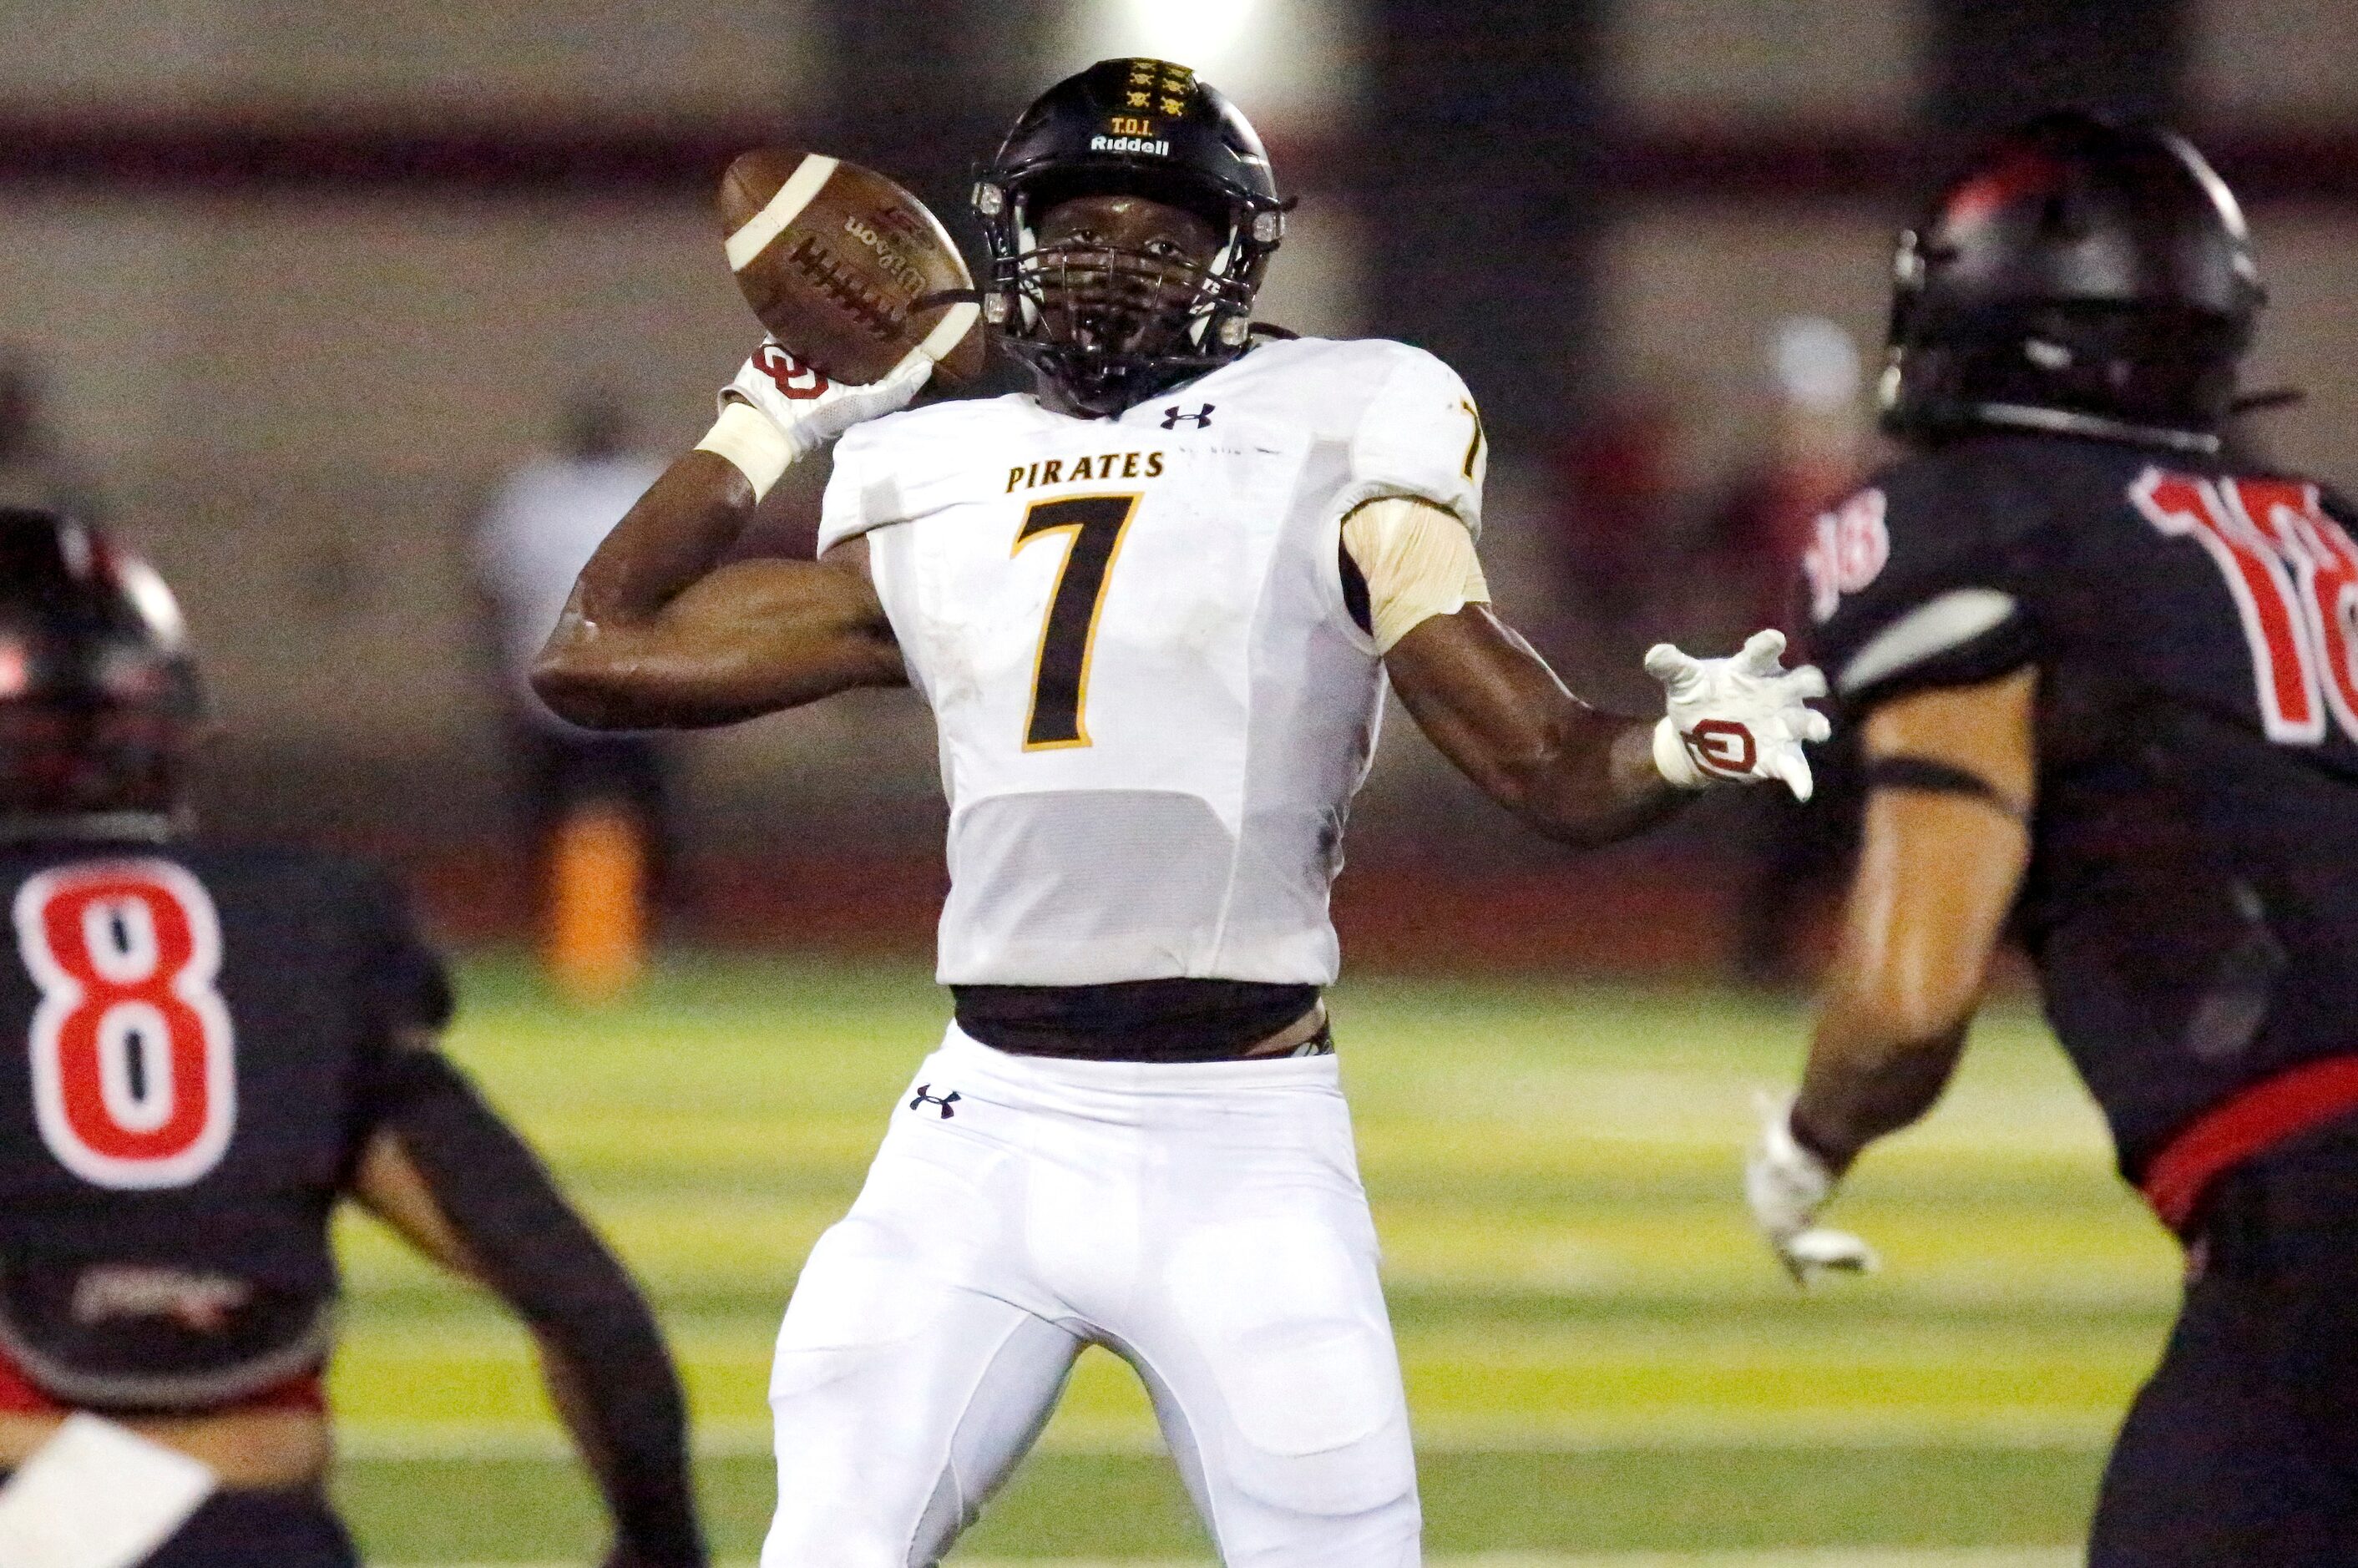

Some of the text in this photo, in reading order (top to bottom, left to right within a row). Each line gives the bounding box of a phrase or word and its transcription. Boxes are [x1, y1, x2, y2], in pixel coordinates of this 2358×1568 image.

[1090, 135, 1169, 156] Riddell
[843, 215, 927, 300] Wilson
[1005, 452, 1164, 493] PIRATES
[1009, 491, 1145, 753] 7
[12, 857, 238, 1191] 8
